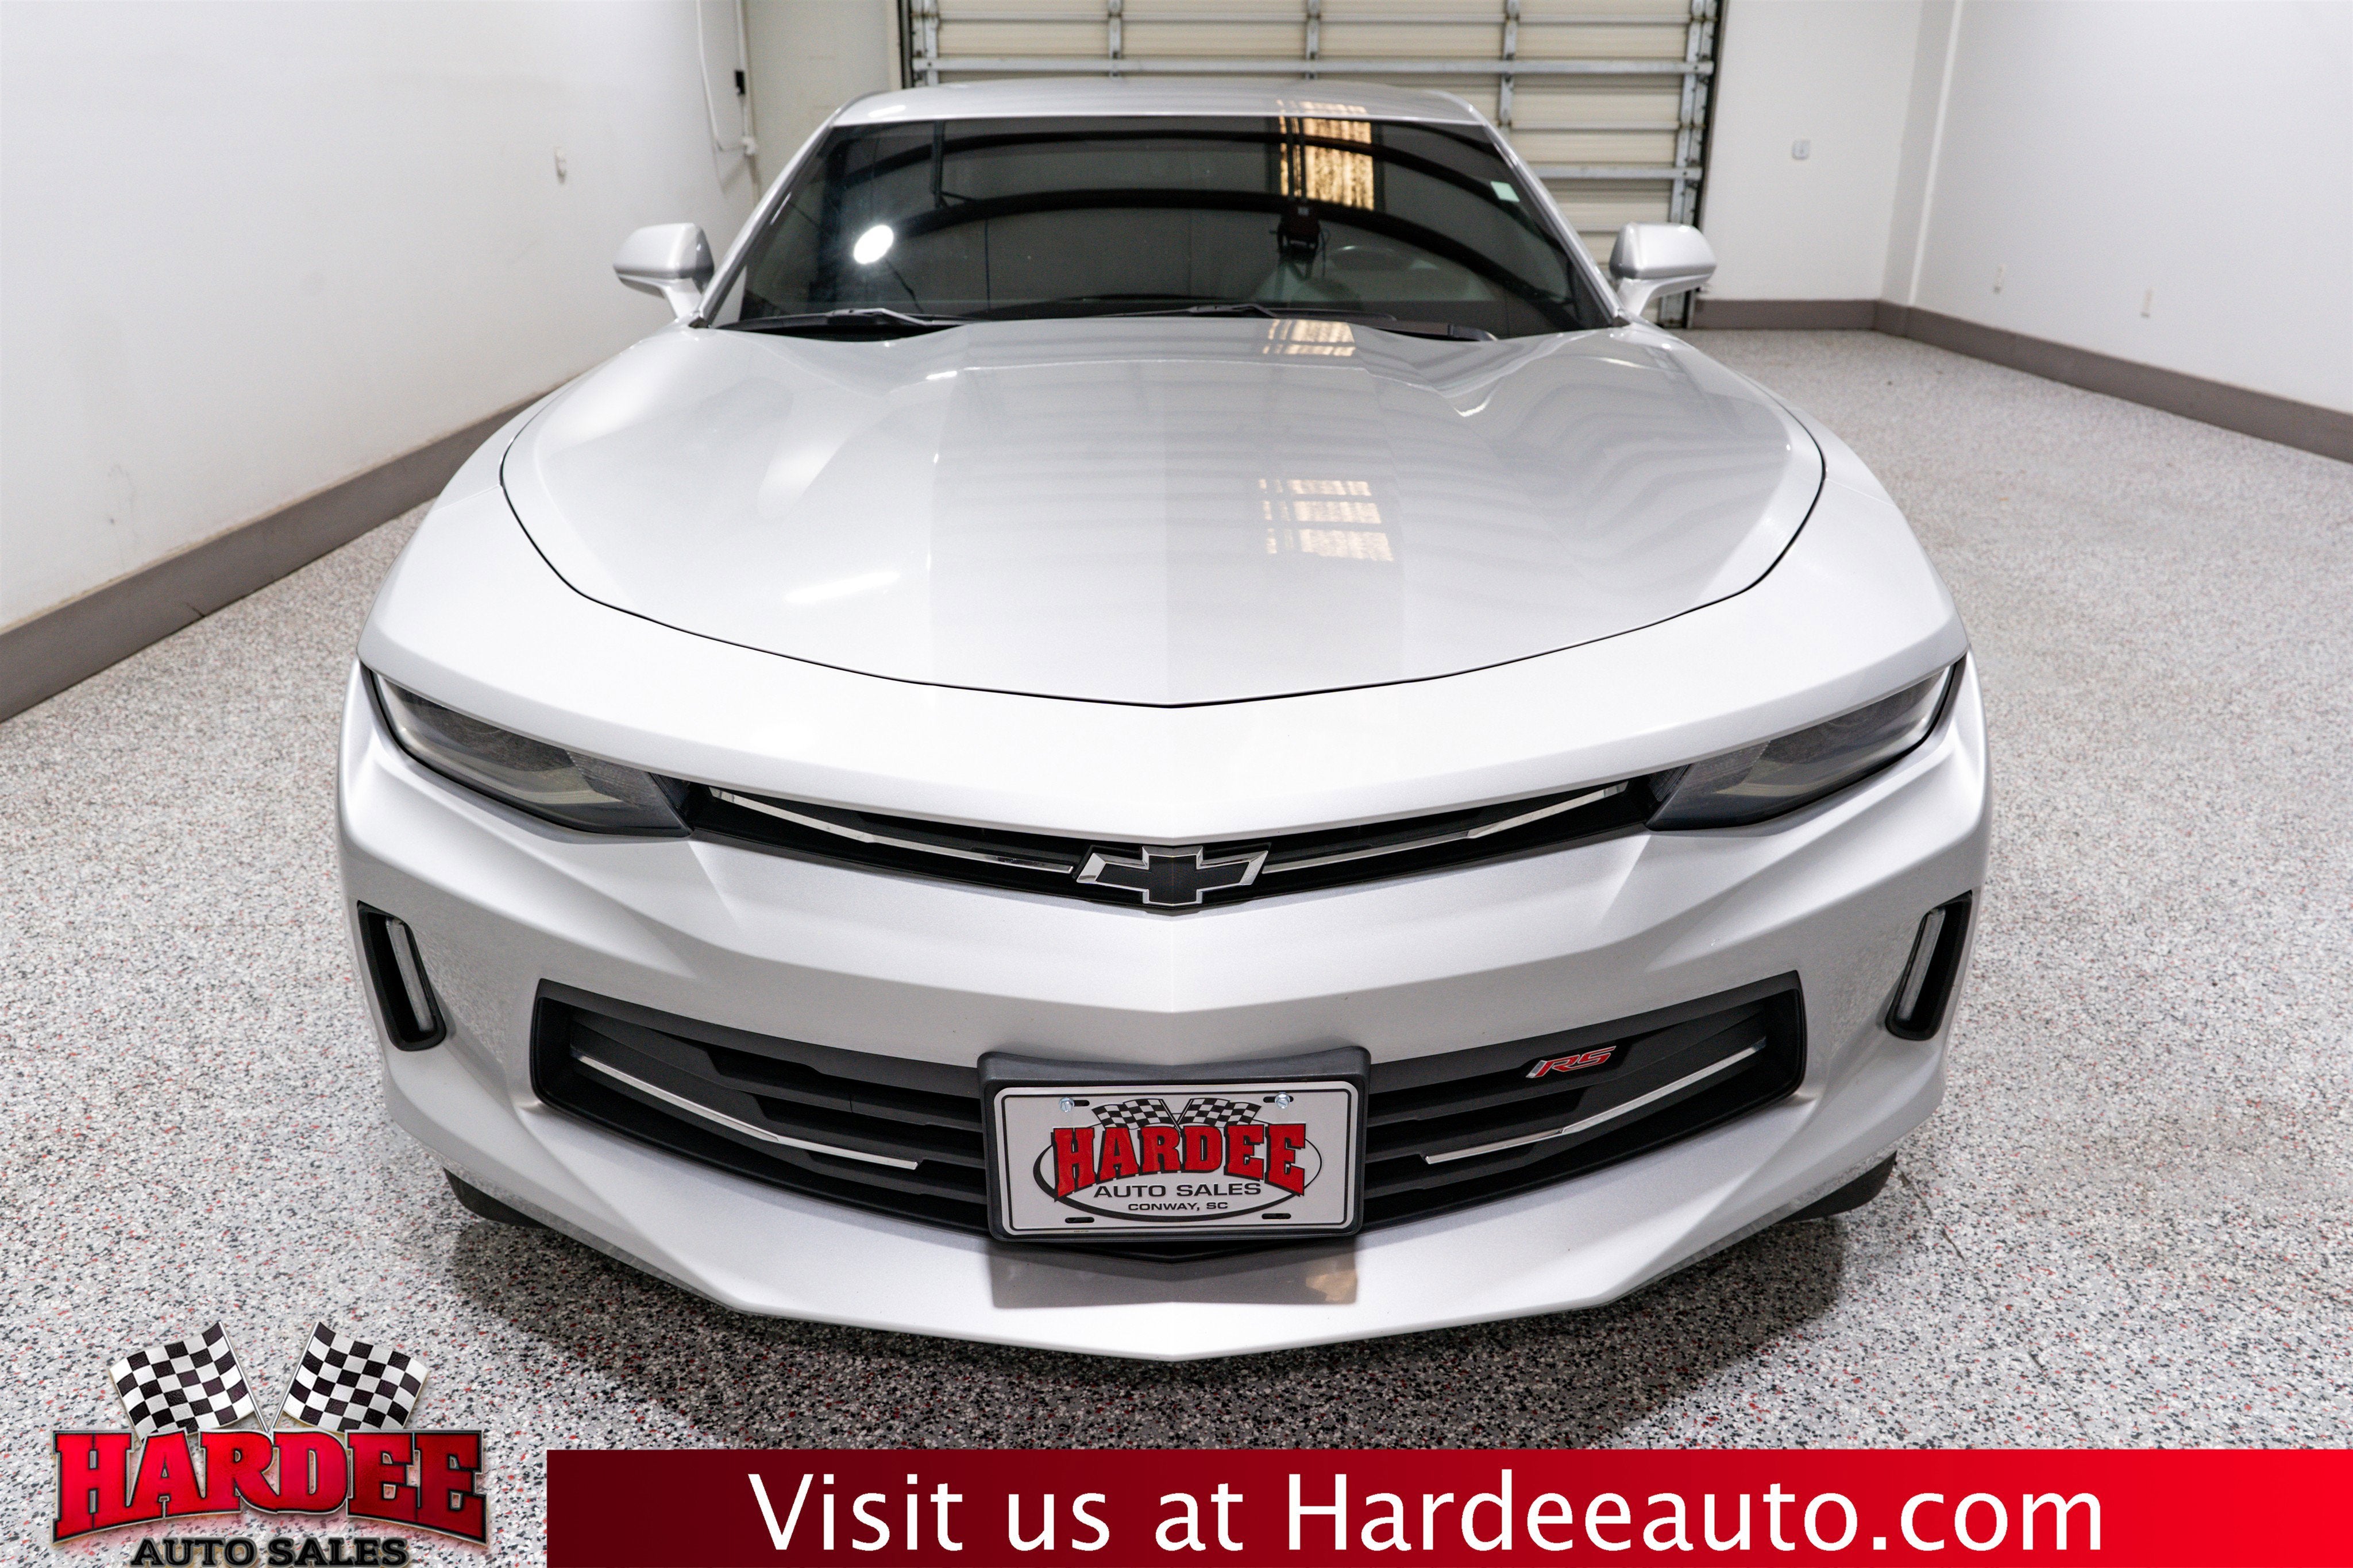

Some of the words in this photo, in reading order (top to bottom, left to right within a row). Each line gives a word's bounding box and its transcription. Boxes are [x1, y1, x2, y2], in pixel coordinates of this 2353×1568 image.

[1526, 1045, 1617, 1078] RS
[1051, 1123, 1306, 1202] HARDEE
[1093, 1185, 1166, 1198] AUTO
[1176, 1183, 1262, 1196] SALES
[1128, 1203, 1200, 1211] CONWAY,
[1206, 1202, 1228, 1210] SC
